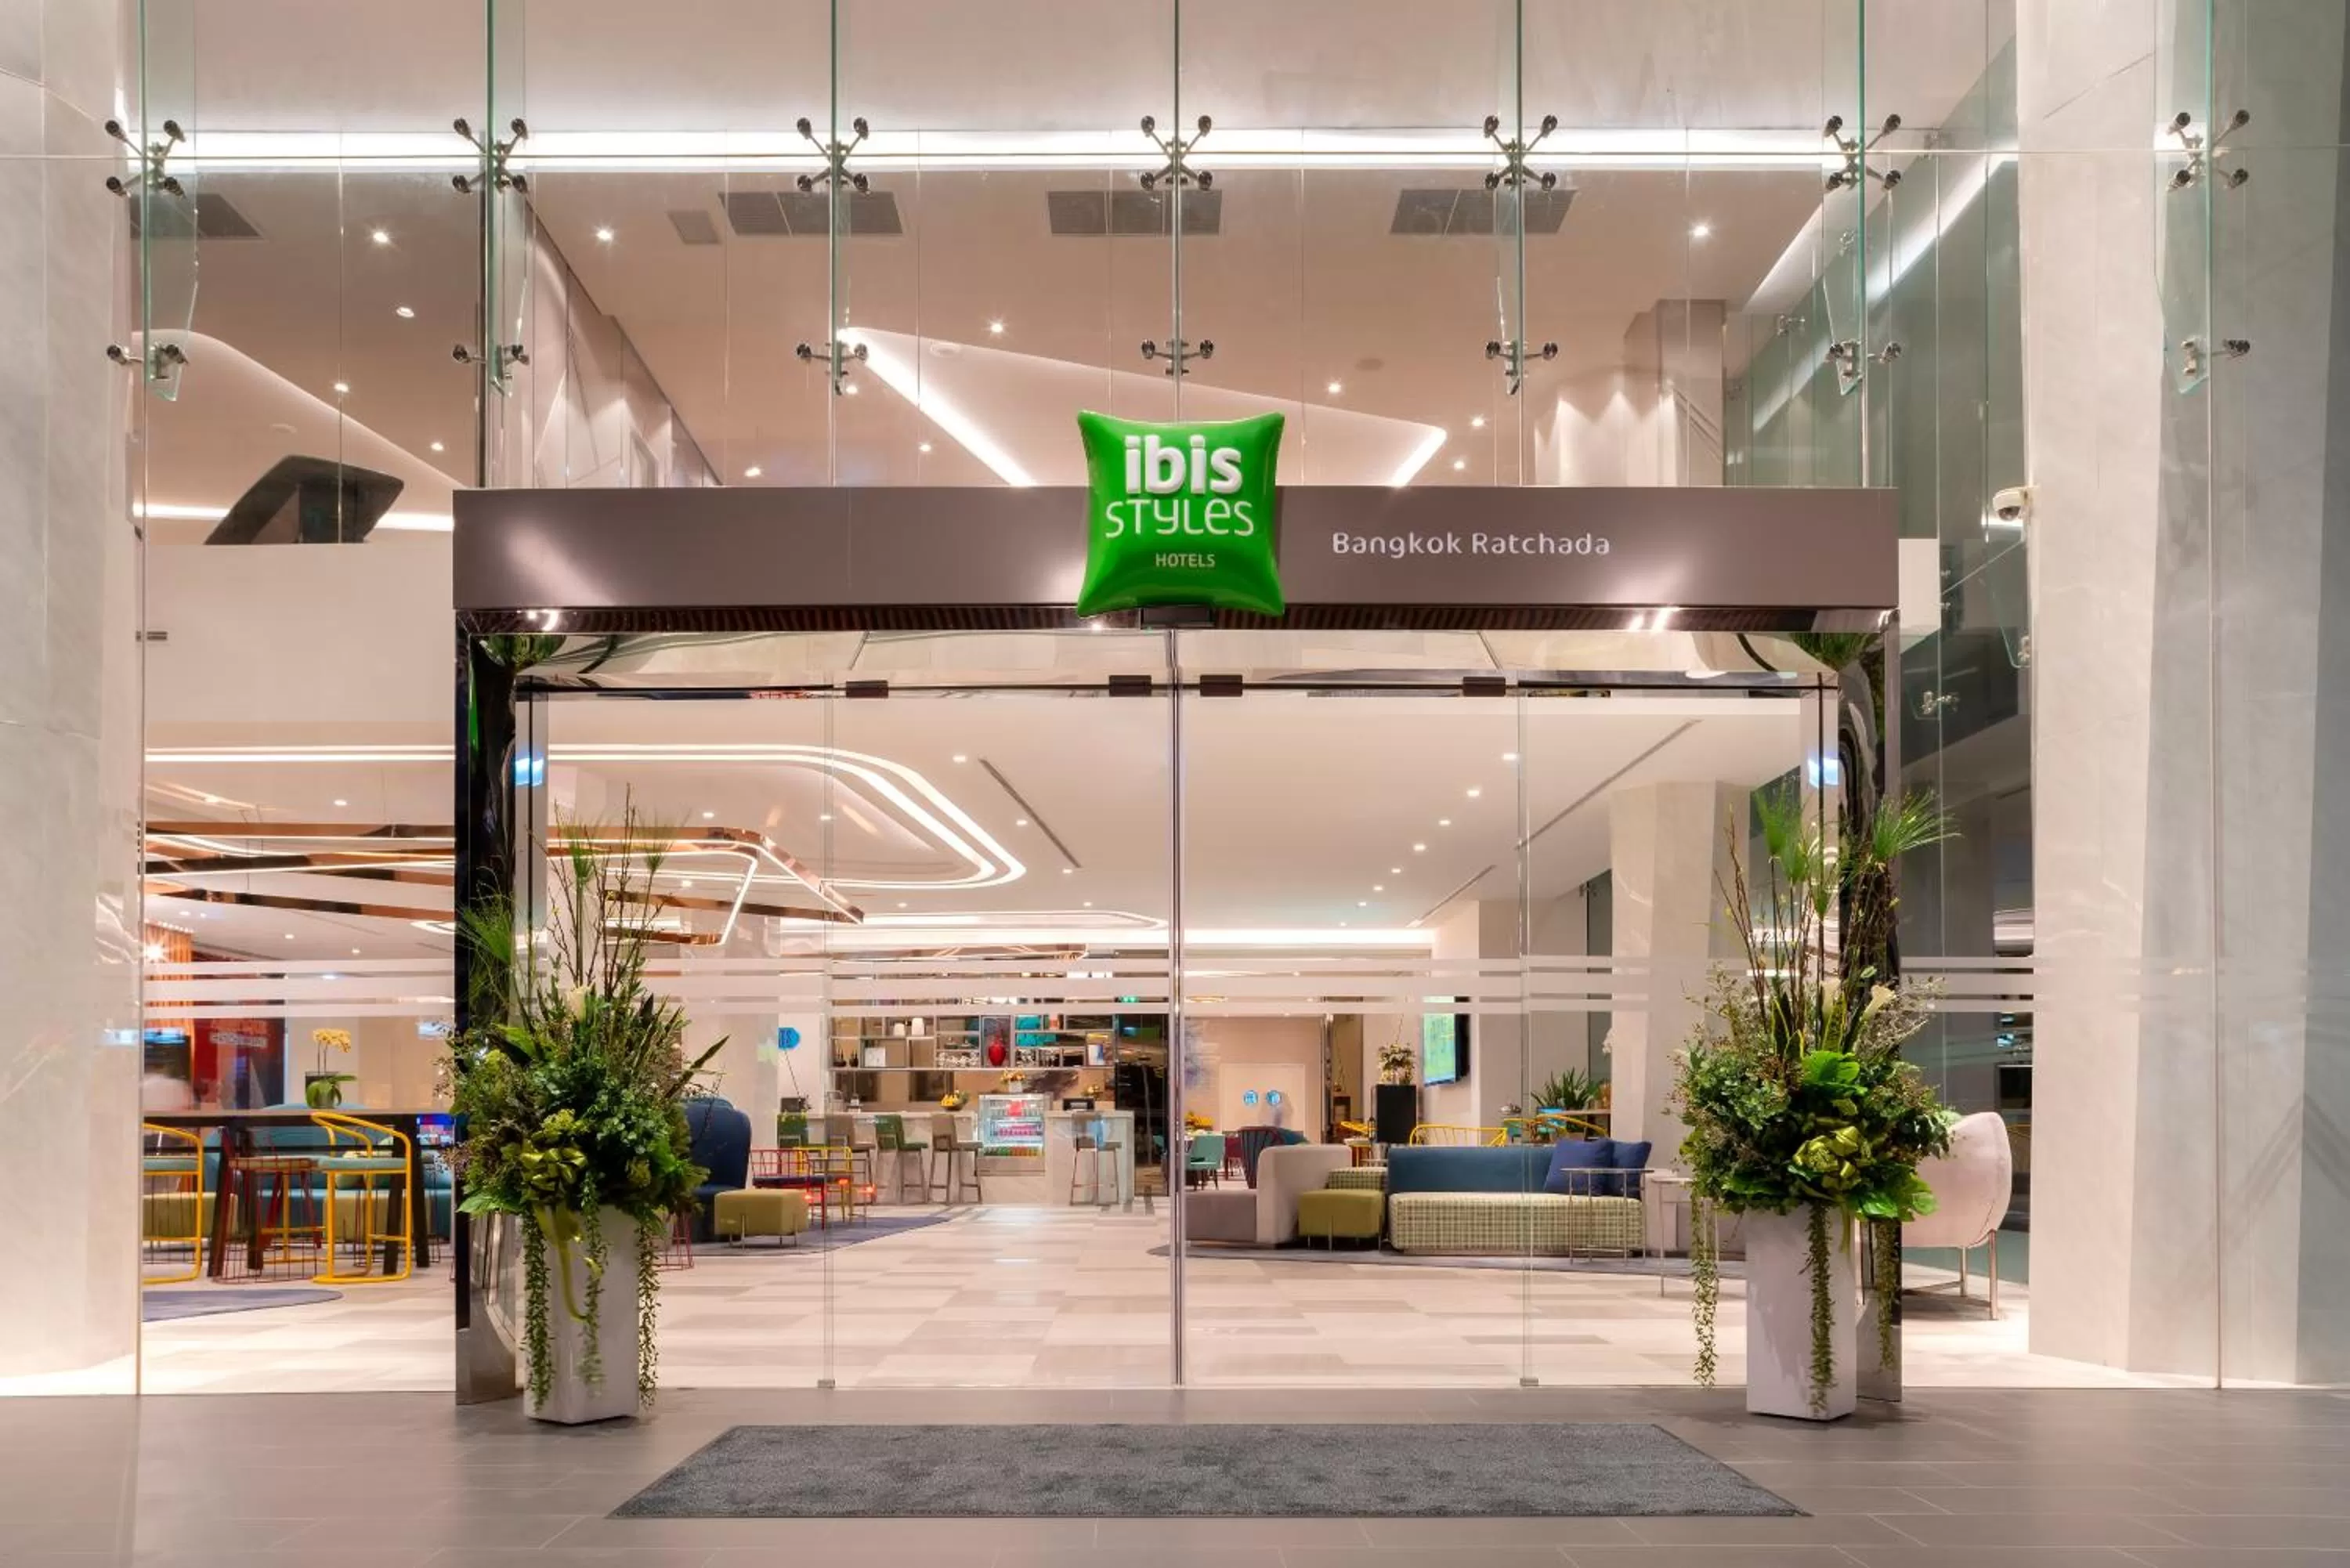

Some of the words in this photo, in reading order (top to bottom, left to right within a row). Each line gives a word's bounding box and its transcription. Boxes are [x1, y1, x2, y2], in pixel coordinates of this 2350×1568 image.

[1125, 435, 1243, 494] ibis
[1332, 532, 1463, 558] Bangkok
[1472, 532, 1611, 555] Ratchada
[1155, 552, 1216, 568] HOTELS
